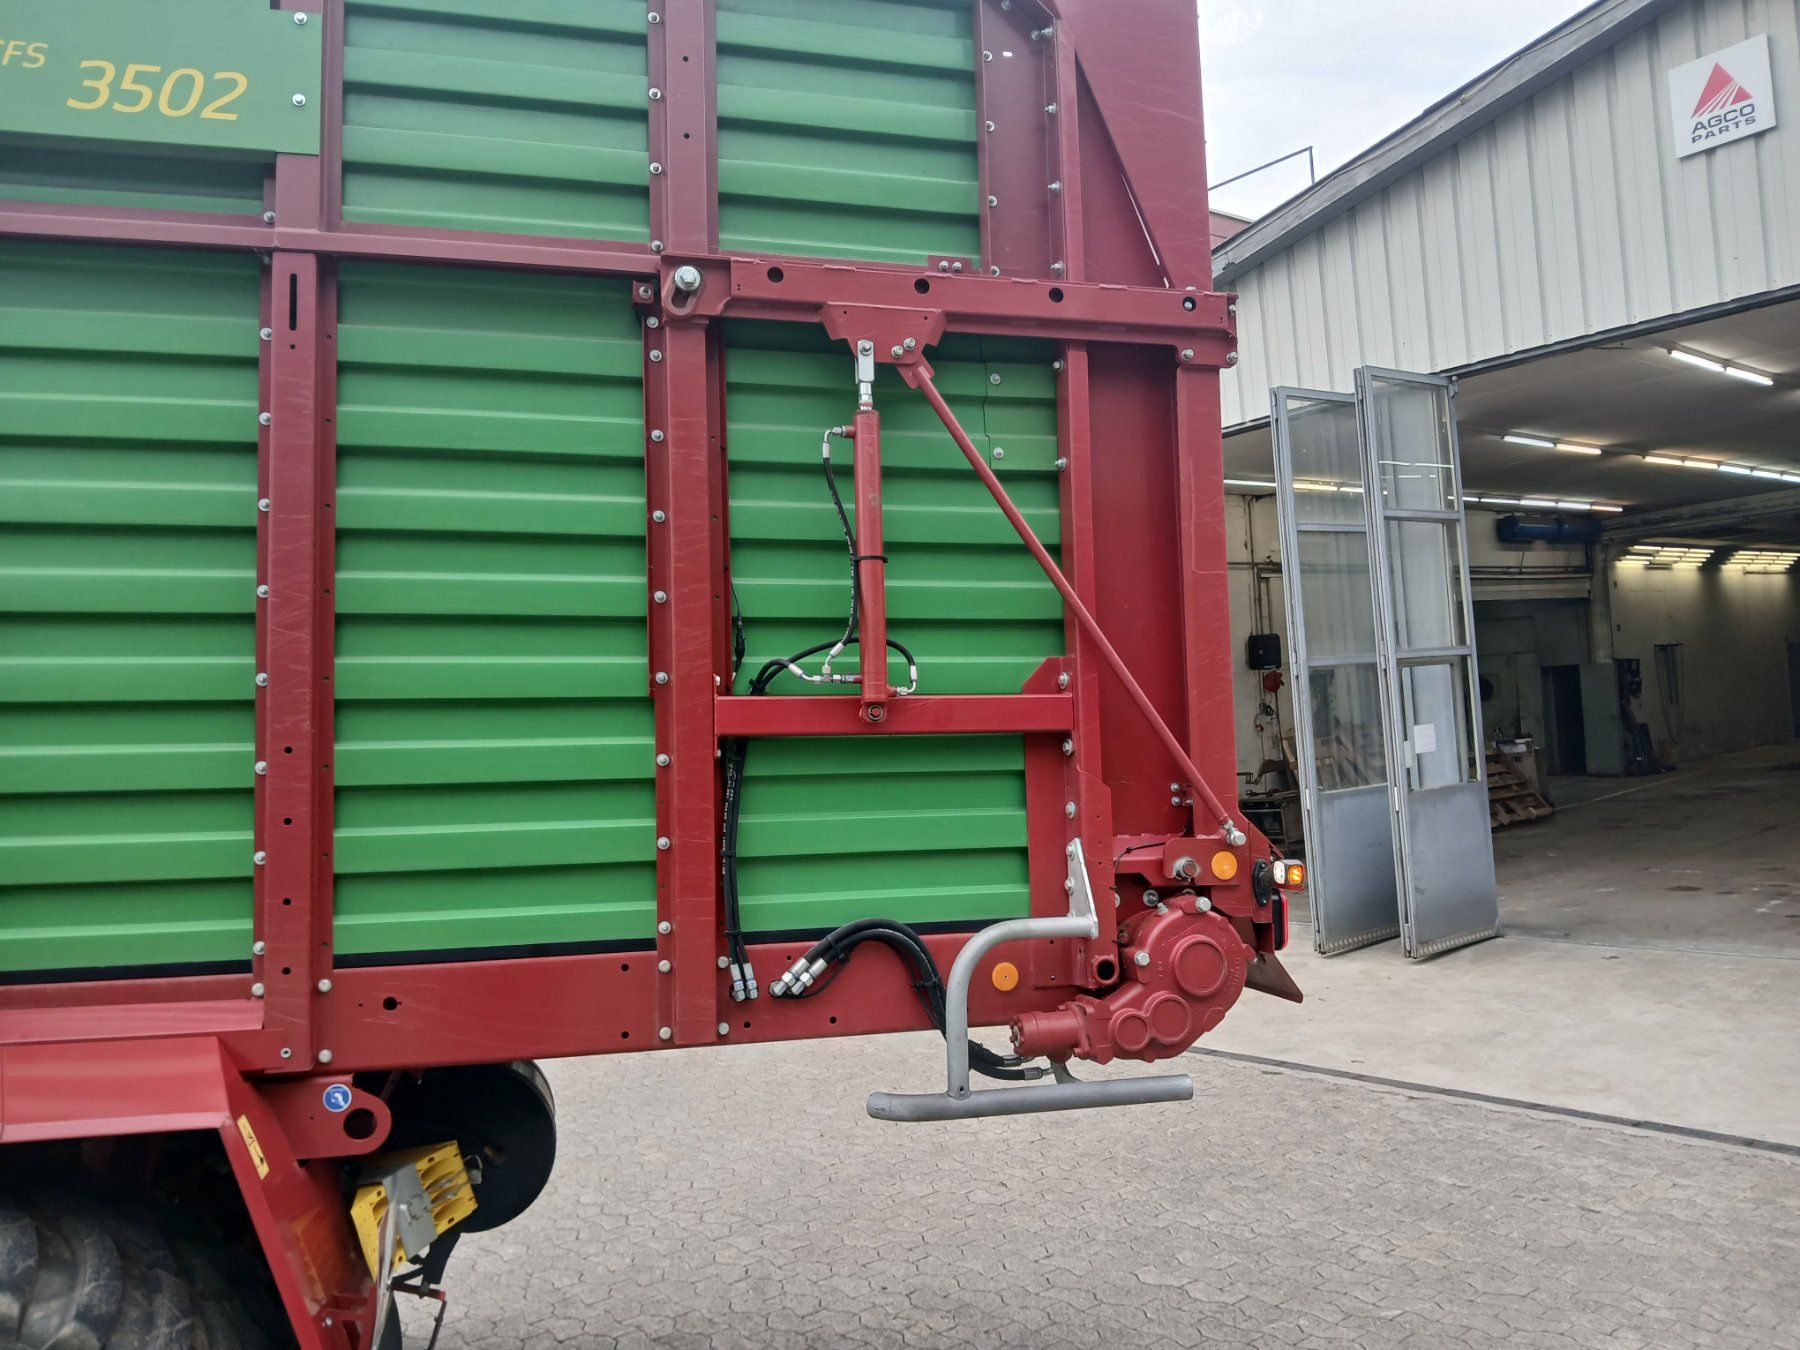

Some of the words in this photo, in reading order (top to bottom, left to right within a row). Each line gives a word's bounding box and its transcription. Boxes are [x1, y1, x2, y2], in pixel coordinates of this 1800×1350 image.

[0, 40, 48, 68] FS
[66, 60, 248, 121] 3502
[1692, 103, 1755, 135] AGCO
[1692, 115, 1756, 144] PARTS
